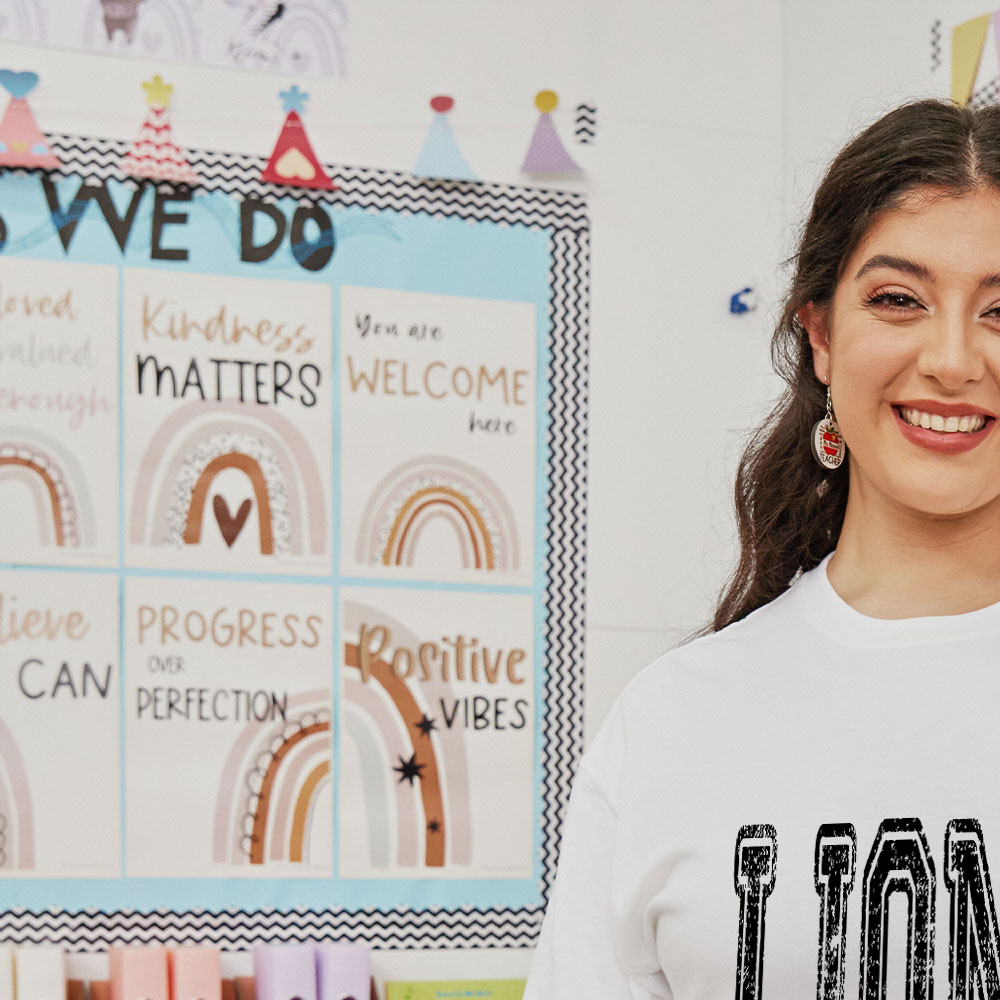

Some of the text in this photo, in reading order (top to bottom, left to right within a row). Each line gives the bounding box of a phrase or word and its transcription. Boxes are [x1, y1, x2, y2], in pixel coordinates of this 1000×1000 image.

[40, 172, 195, 262] WE
[239, 192, 337, 272] DO
[0, 279, 79, 321] oved
[141, 296, 317, 354] Kindness
[355, 313, 444, 342] You are
[136, 354, 322, 407] MATTERS
[347, 355, 530, 406] WELCOME
[468, 411, 518, 435] here
[138, 605, 323, 650] PROGRESS
[148, 655, 186, 675] OVER
[357, 622, 527, 686] Positive
[18, 658, 113, 700] CAN
[137, 686, 289, 723] PERFECTION
[439, 697, 530, 731] VIBES
